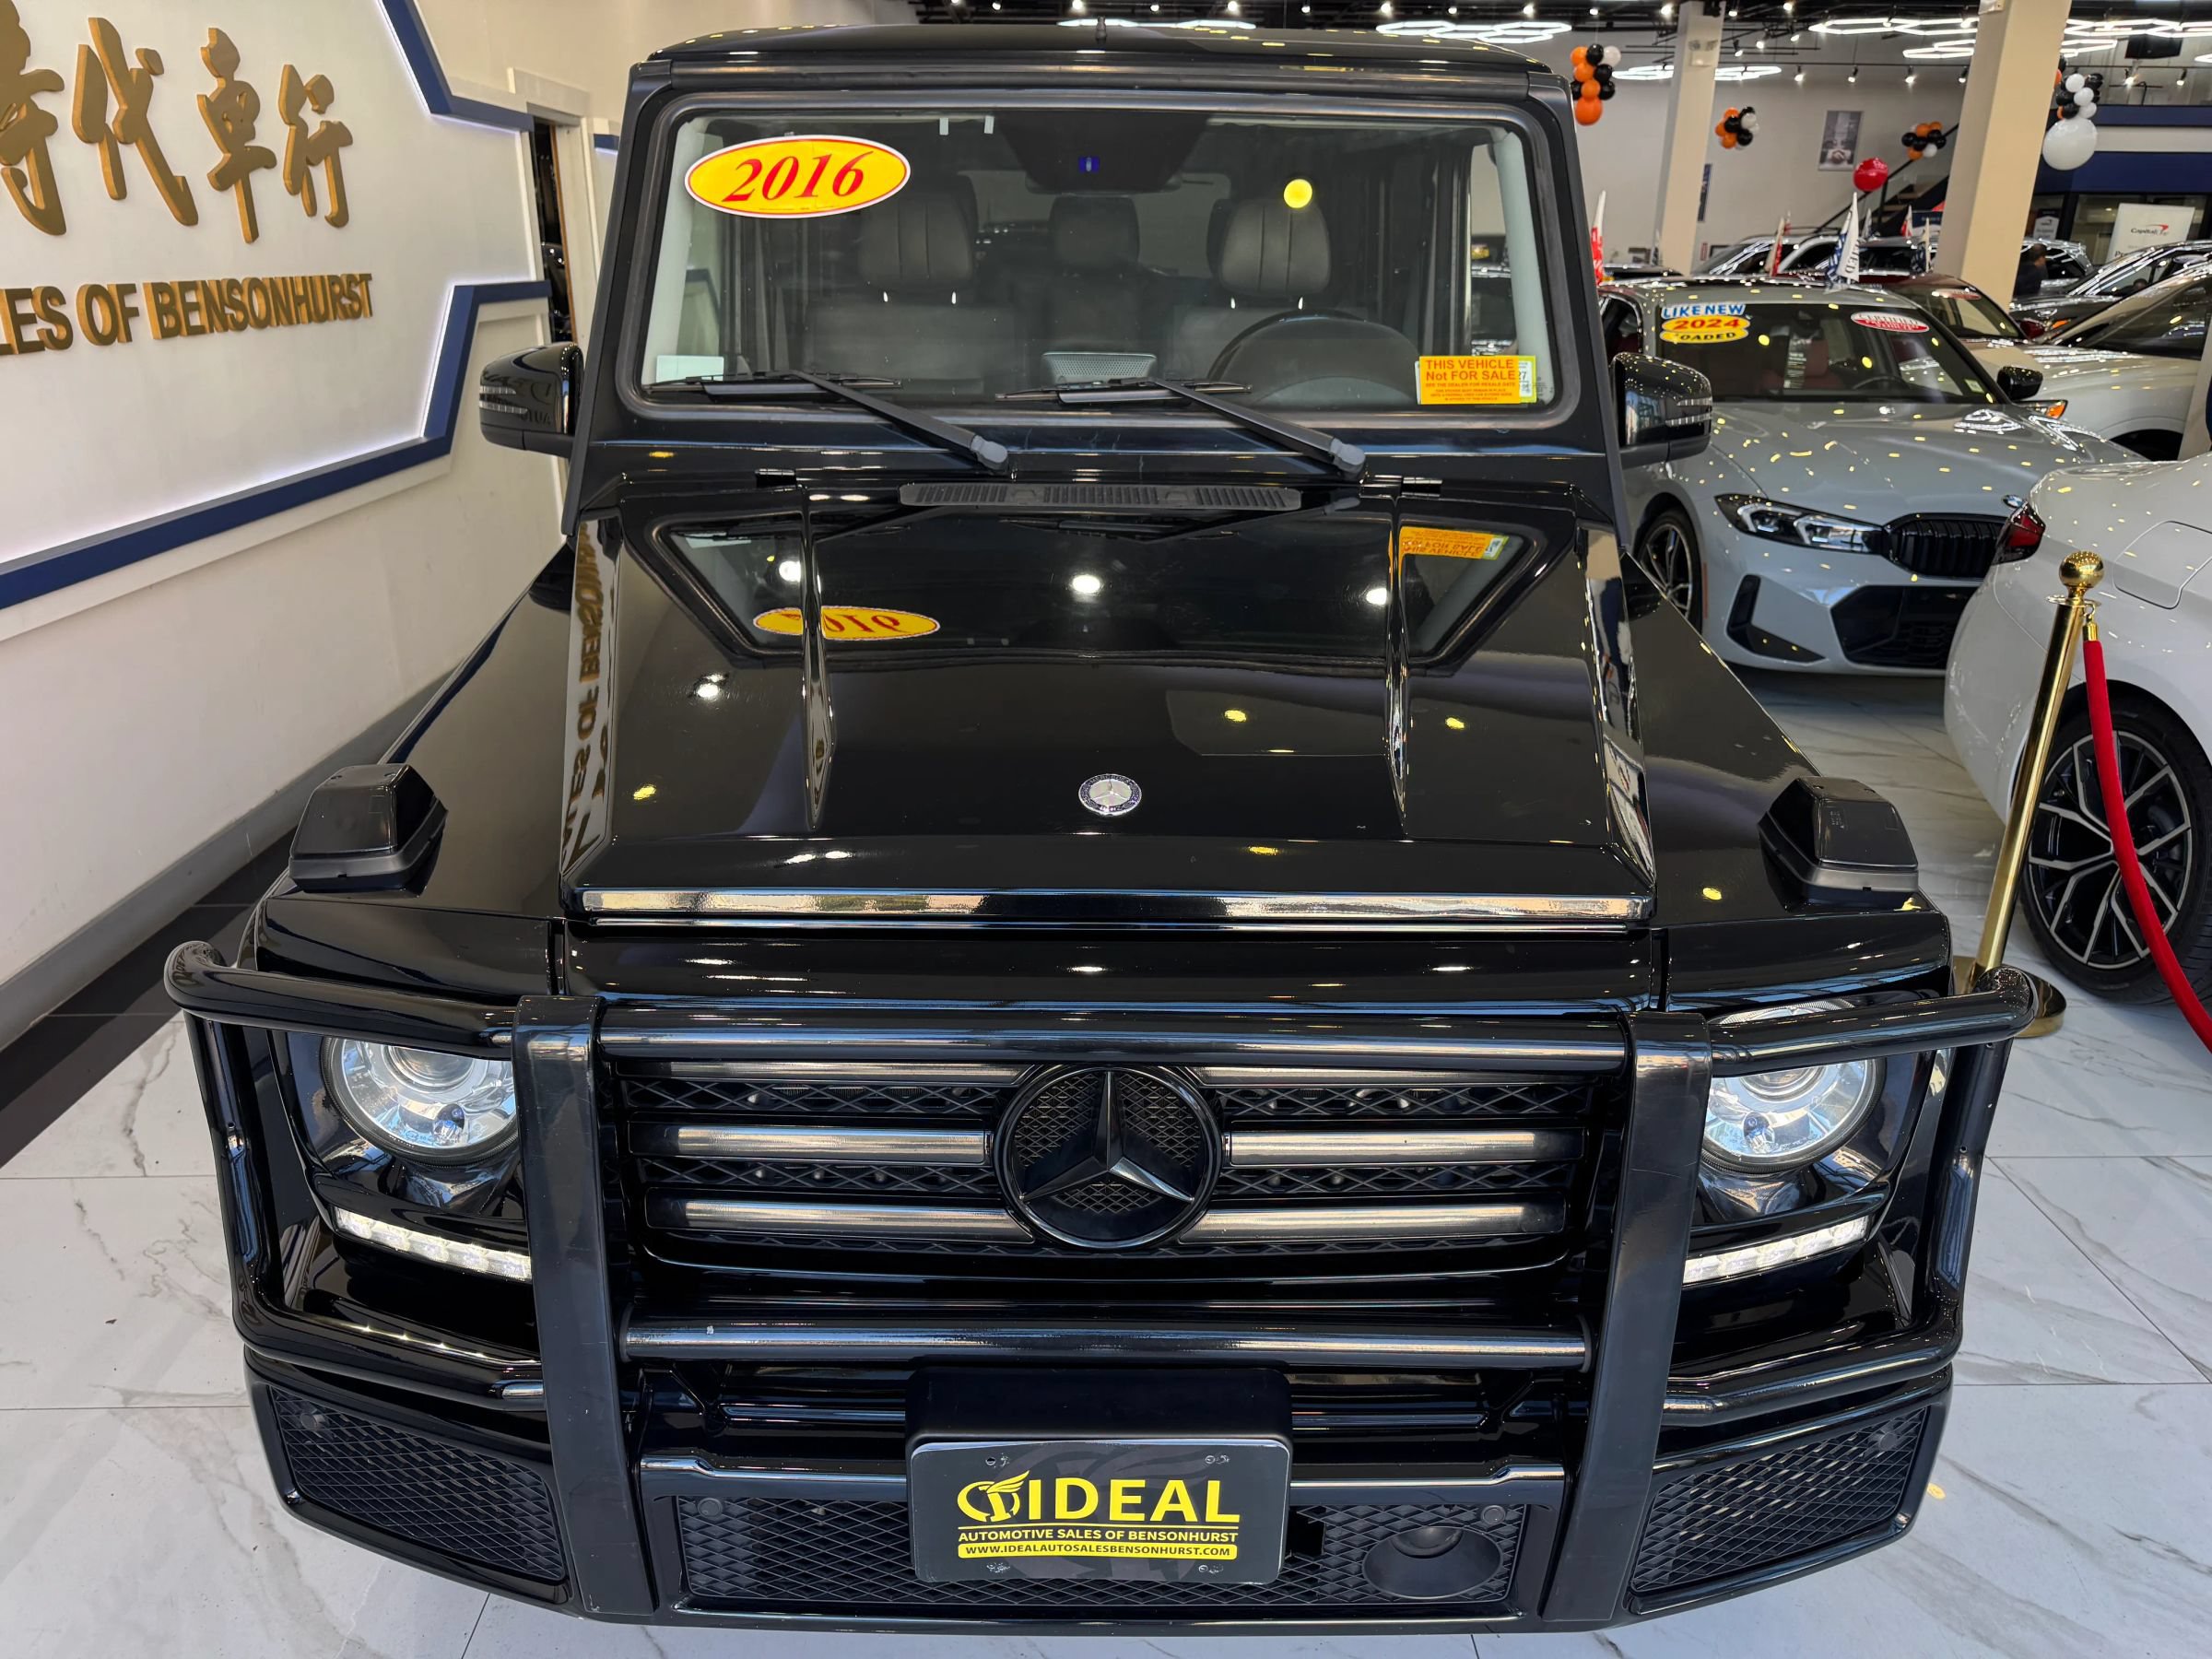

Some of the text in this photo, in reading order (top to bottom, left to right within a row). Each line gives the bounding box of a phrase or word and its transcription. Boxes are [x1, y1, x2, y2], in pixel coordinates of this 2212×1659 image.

[722, 150, 875, 203] 2016
[76, 283, 140, 347] OF
[142, 274, 372, 340] BENSONHURST
[1663, 303, 1744, 319] LIKE NEW
[1673, 318, 1740, 331] 2024
[1426, 359, 1454, 370] THIS
[1458, 359, 1514, 370] VEHICLE
[1426, 370, 1516, 382] Not FOR SALE
[1028, 1477, 1241, 1523] IDEAL
[959, 1528, 1239, 1543] AUTOMOTIVE SALES OF BENSONHURST
[965, 1544, 1230, 1556] WWW.IDEALAUTOSALESBENSONHURST.COM
